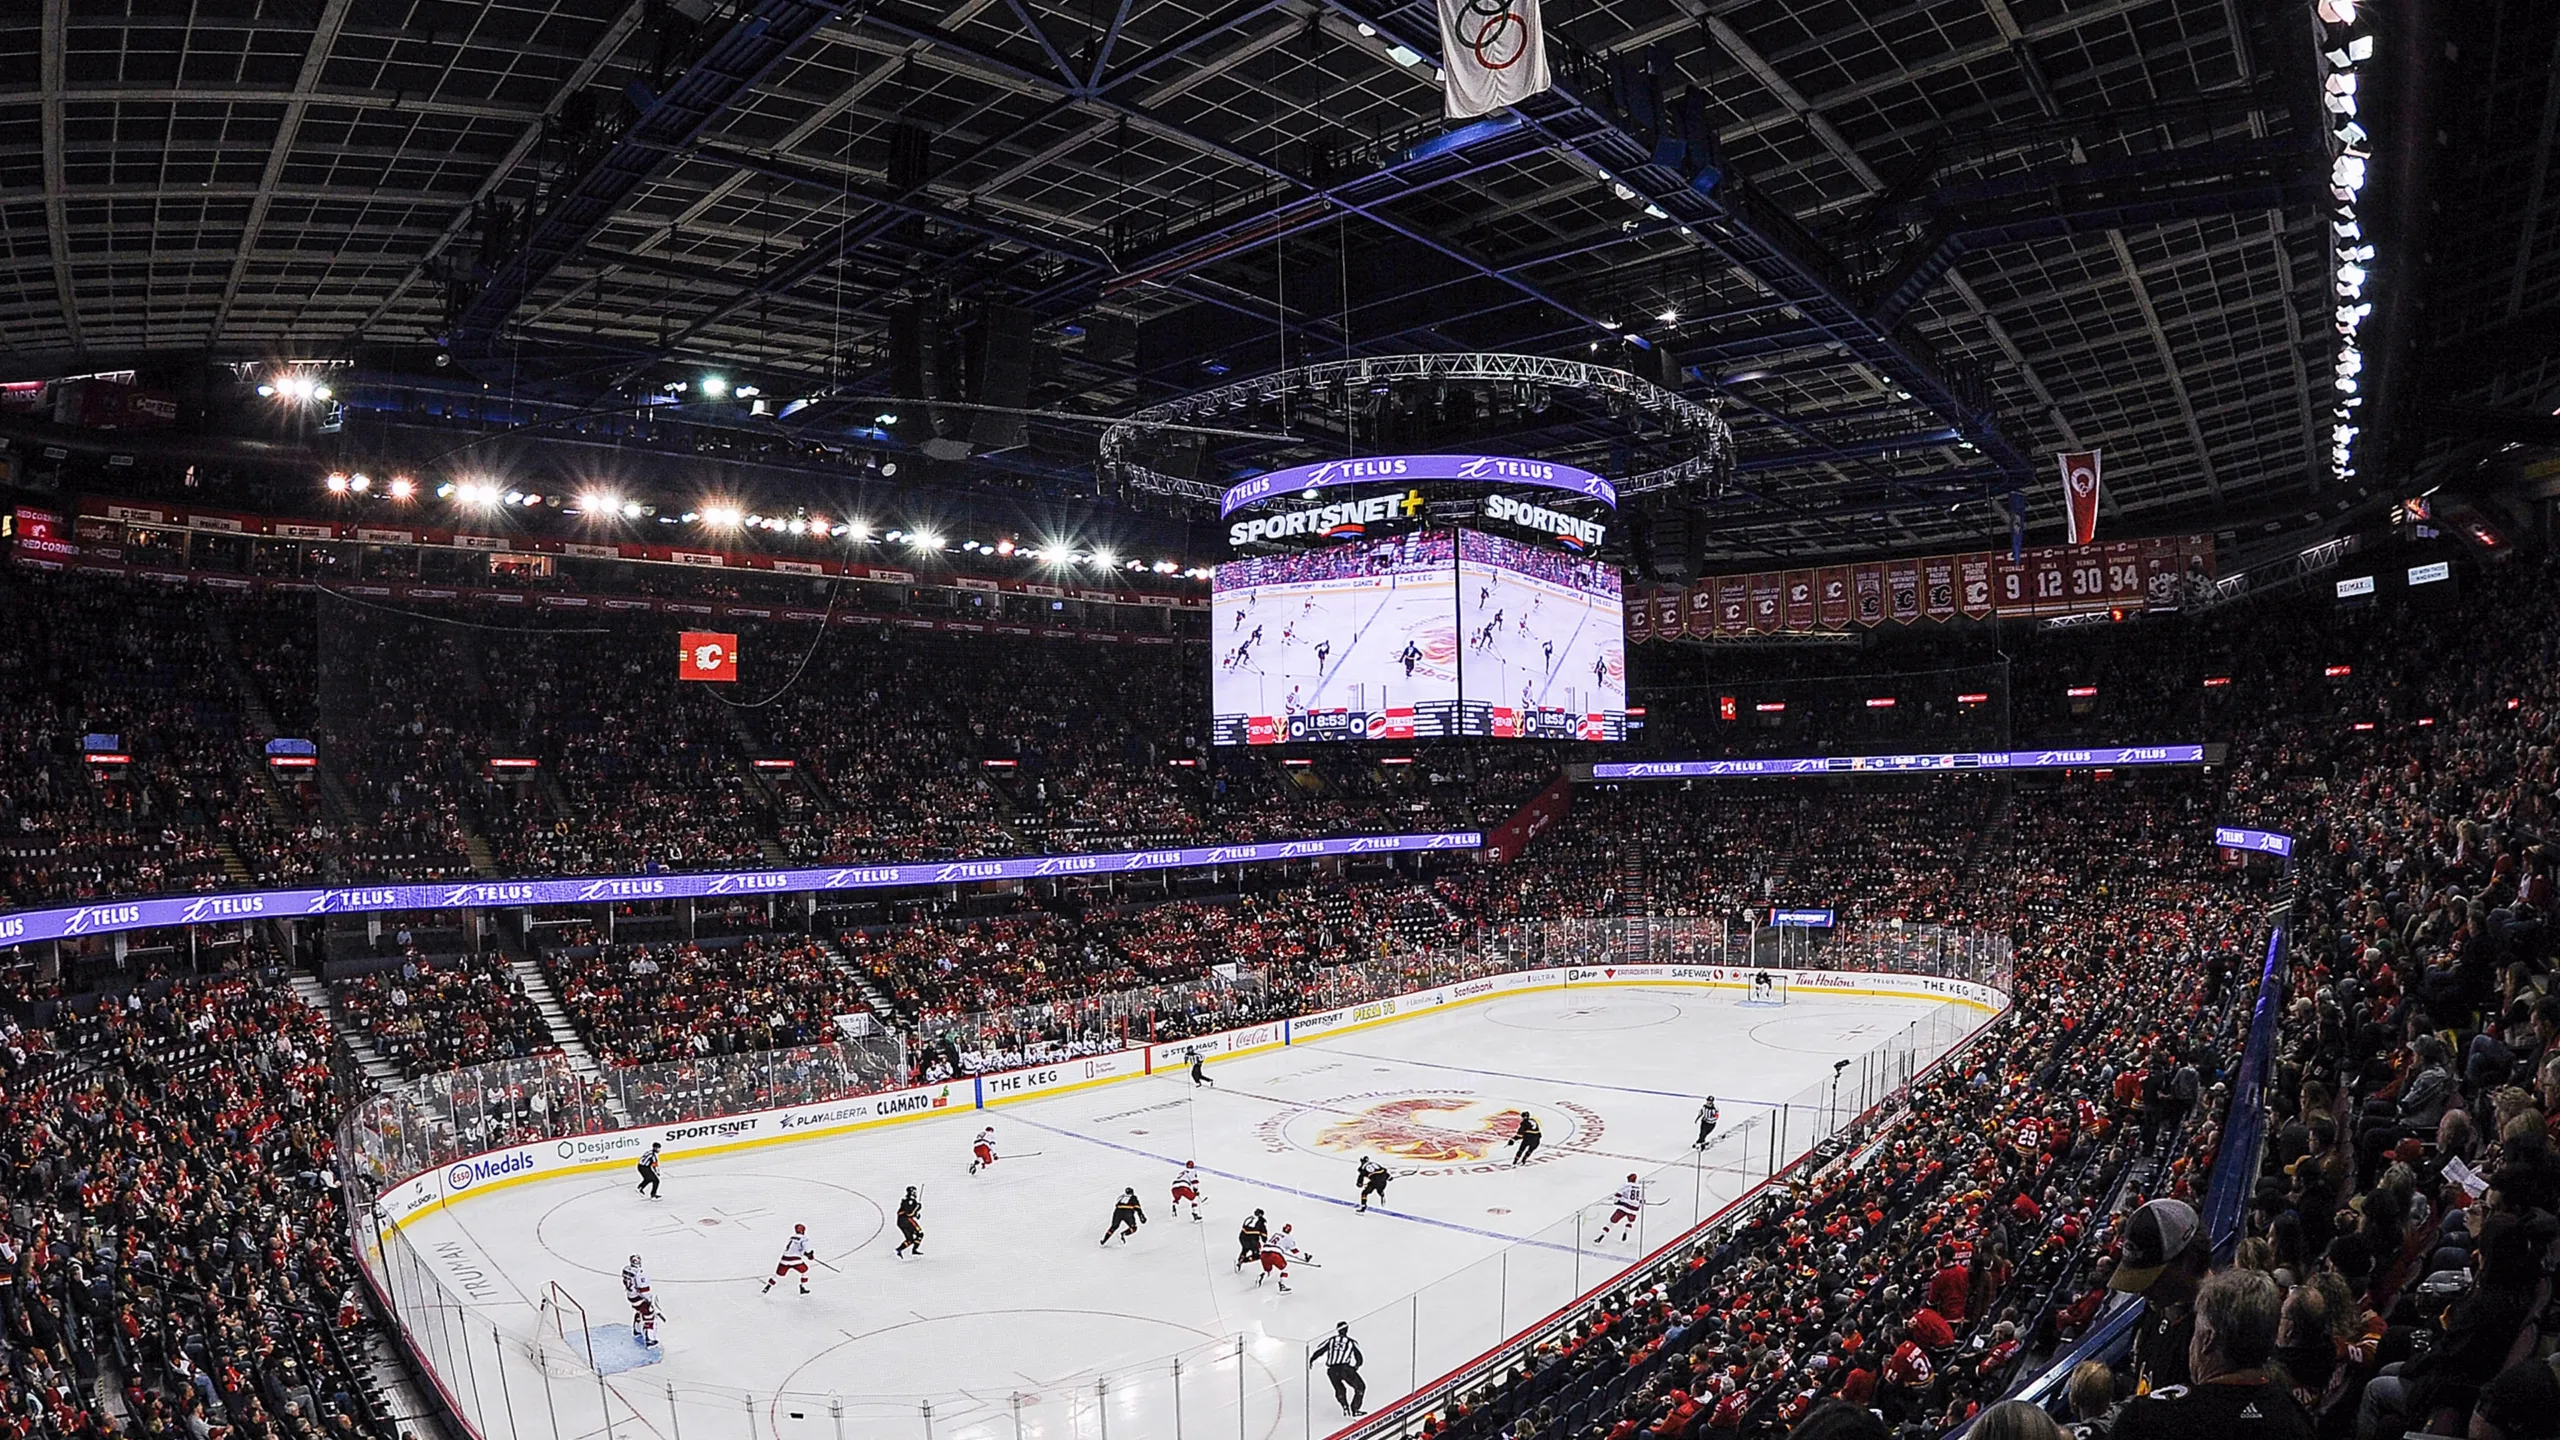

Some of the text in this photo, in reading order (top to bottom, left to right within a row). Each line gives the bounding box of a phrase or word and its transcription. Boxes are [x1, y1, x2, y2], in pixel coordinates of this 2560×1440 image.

[1340, 460, 1407, 477] TELUS
[1496, 461, 1553, 480] TELUS
[1235, 478, 1270, 500] TELUS
[17, 509, 31, 519] RED
[1485, 494, 1606, 545] SPORTSNET
[22, 539, 80, 555] RED CORNER
[2006, 574, 2020, 600] 9
[2037, 571, 2063, 597] 12
[2073, 568, 2102, 595] 30
[2109, 565, 2139, 592] 34
[1292, 714, 1365, 737] 0 18:53 0
[1527, 717, 1537, 732] 0
[1539, 713, 1565, 725] 18:53
[1566, 720, 1575, 734] 0
[2056, 752, 2091, 762] TELUS
[2135, 749, 2166, 760] TELUS
[1647, 764, 1681, 774] TELUS
[1730, 762, 1763, 772] TELUS
[1296, 842, 1325, 854] TELUS
[1368, 837, 1400, 849] TELUS
[1145, 852, 1181, 865] TELUS
[1225, 847, 1257, 859] TELUS
[960, 863, 1002, 877] TELUS
[1057, 857, 1096, 871] TELUS
[736, 874, 787, 889] TELUS
[853, 869, 899, 884] TELUS
[477, 885, 532, 901] TELUS
[611, 880, 664, 896] TELUS
[211, 897, 263, 915] TELUS
[340, 890, 395, 907] TELUS
[90, 906, 140, 925] TELUS
[1532, 974, 1556, 983] ULTRA
[1650, 968, 1664, 976] TIRE
[1672, 968, 1712, 978] SAFEWAY
[1795, 973, 1855, 988] Tim Hortons
[1454, 981, 1493, 998] Scotiabank
[1923, 981, 1969, 996] THE KEG
[1353, 1001, 1396, 1022] PIZZA 73
[1294, 1012, 1343, 1031] SPORTSNET
[989, 1070, 1058, 1093] THE KEG
[876, 1095, 929, 1116] CLAMATO
[797, 1106, 868, 1127] PLAYALBERTA
[666, 1119, 758, 1142] SPORTSNET
[2018, 1128, 2038, 1147] 29
[577, 1136, 640, 1155] Desjardins
[474, 1151, 534, 1181] Medals
[579, 1155, 609, 1164] Insurance
[431, 1241, 498, 1301] TRUMAN
